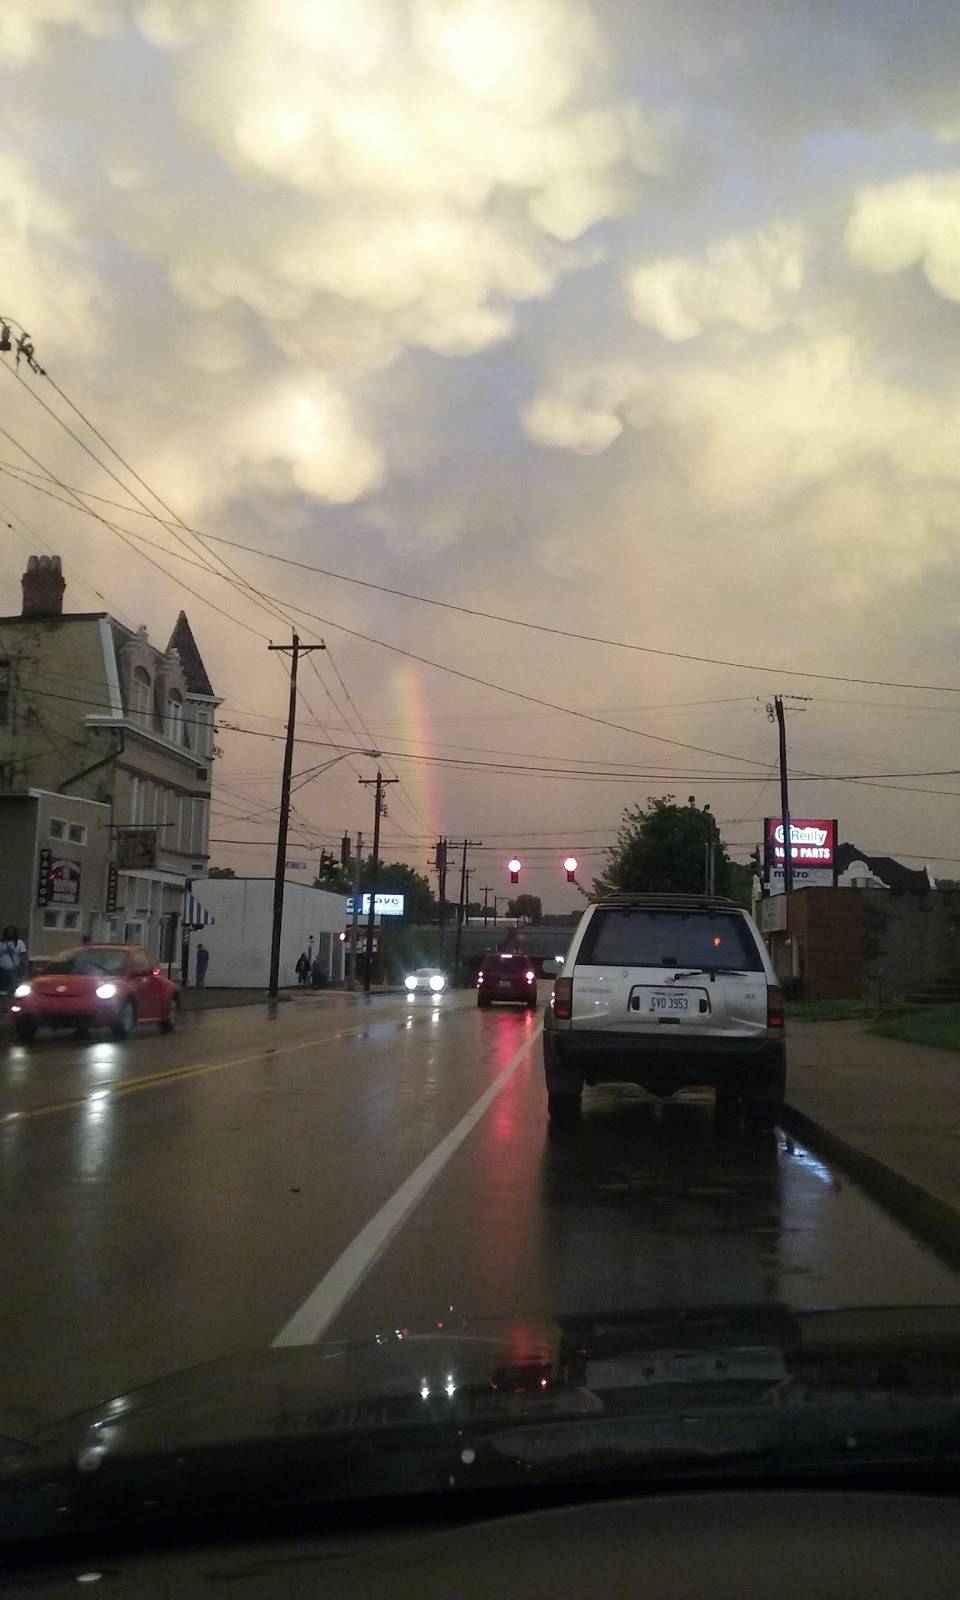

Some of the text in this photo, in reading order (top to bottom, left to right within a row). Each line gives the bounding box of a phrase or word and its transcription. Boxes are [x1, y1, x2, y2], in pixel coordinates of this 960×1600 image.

[776, 826, 826, 845] OReilly
[774, 847, 831, 859] AUO PARTS
[39, 850, 49, 905] TATTOO
[773, 868, 809, 879] mtro
